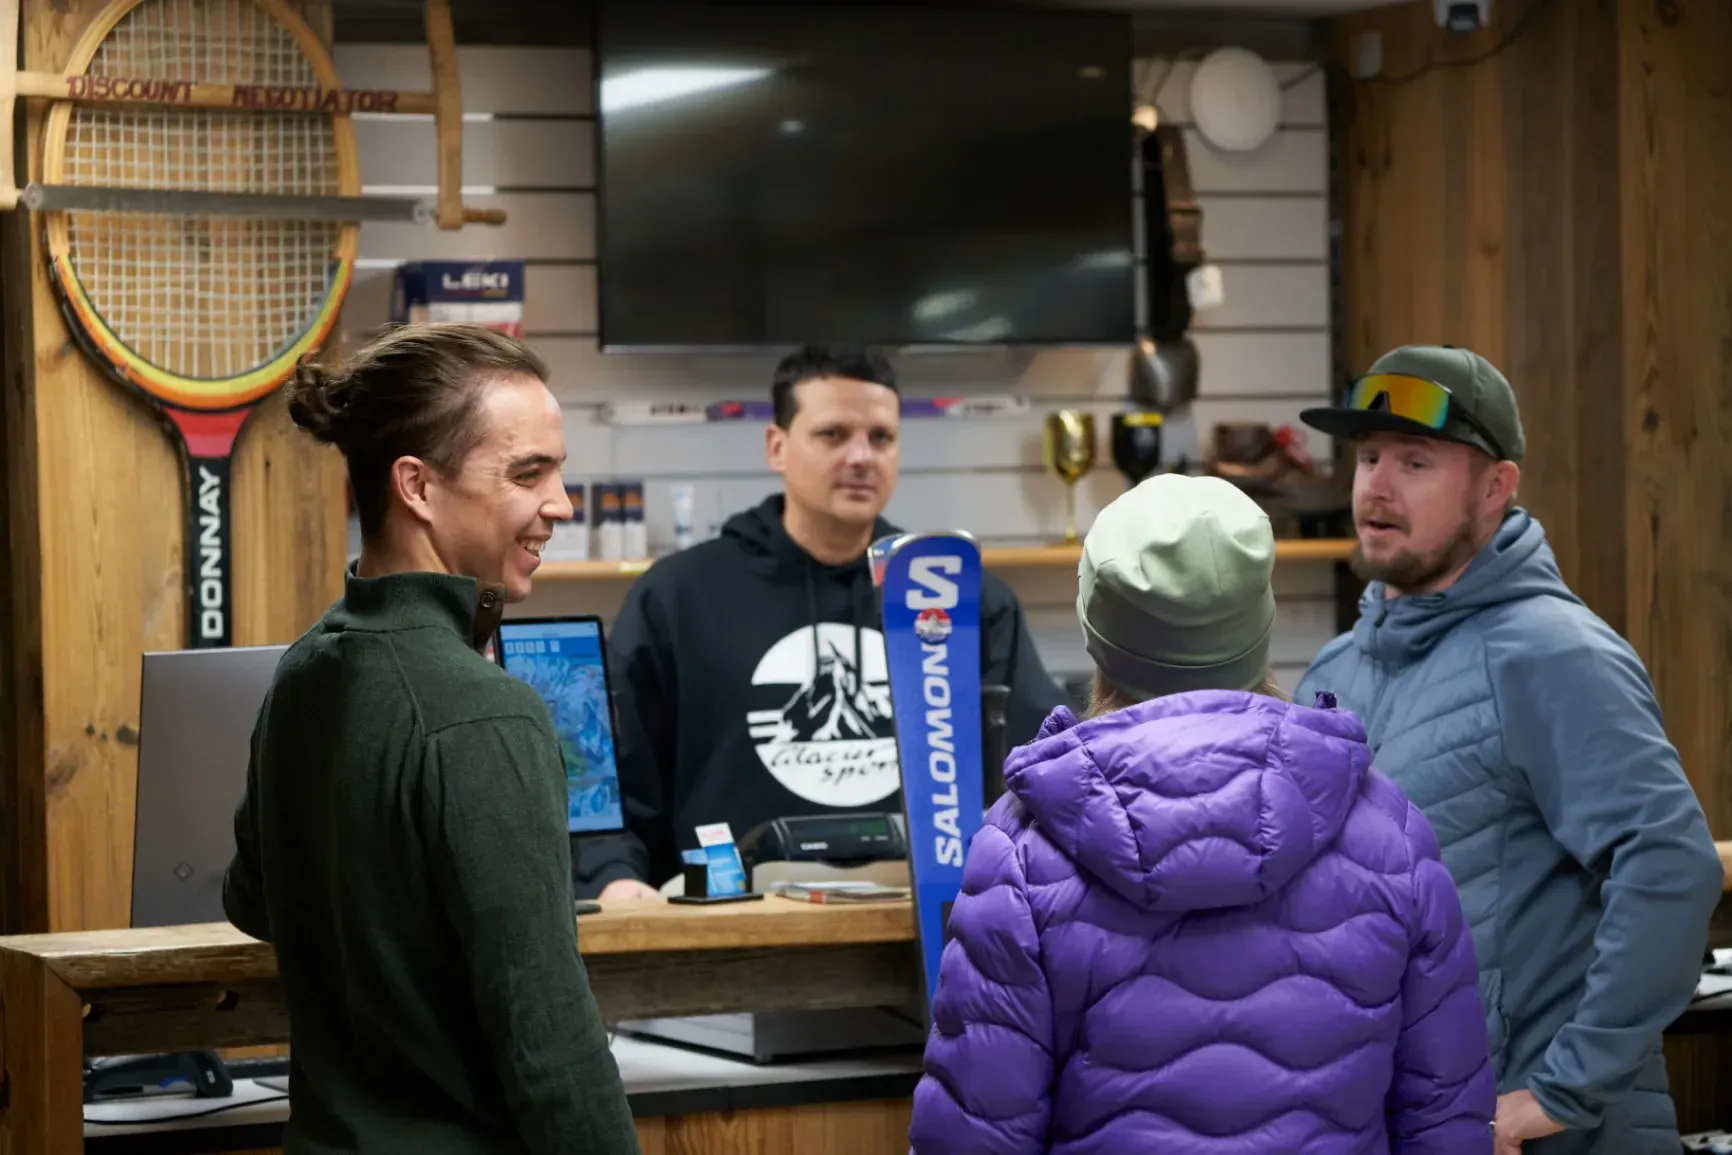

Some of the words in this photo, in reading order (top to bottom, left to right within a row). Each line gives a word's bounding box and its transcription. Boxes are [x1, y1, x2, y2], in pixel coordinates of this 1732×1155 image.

[66, 75, 198, 104] DISCOUNT
[233, 83, 399, 113] NEGOTIATOR
[441, 271, 510, 290] LEKI
[198, 465, 224, 638] DONNAY
[920, 642, 964, 868] SALOMON
